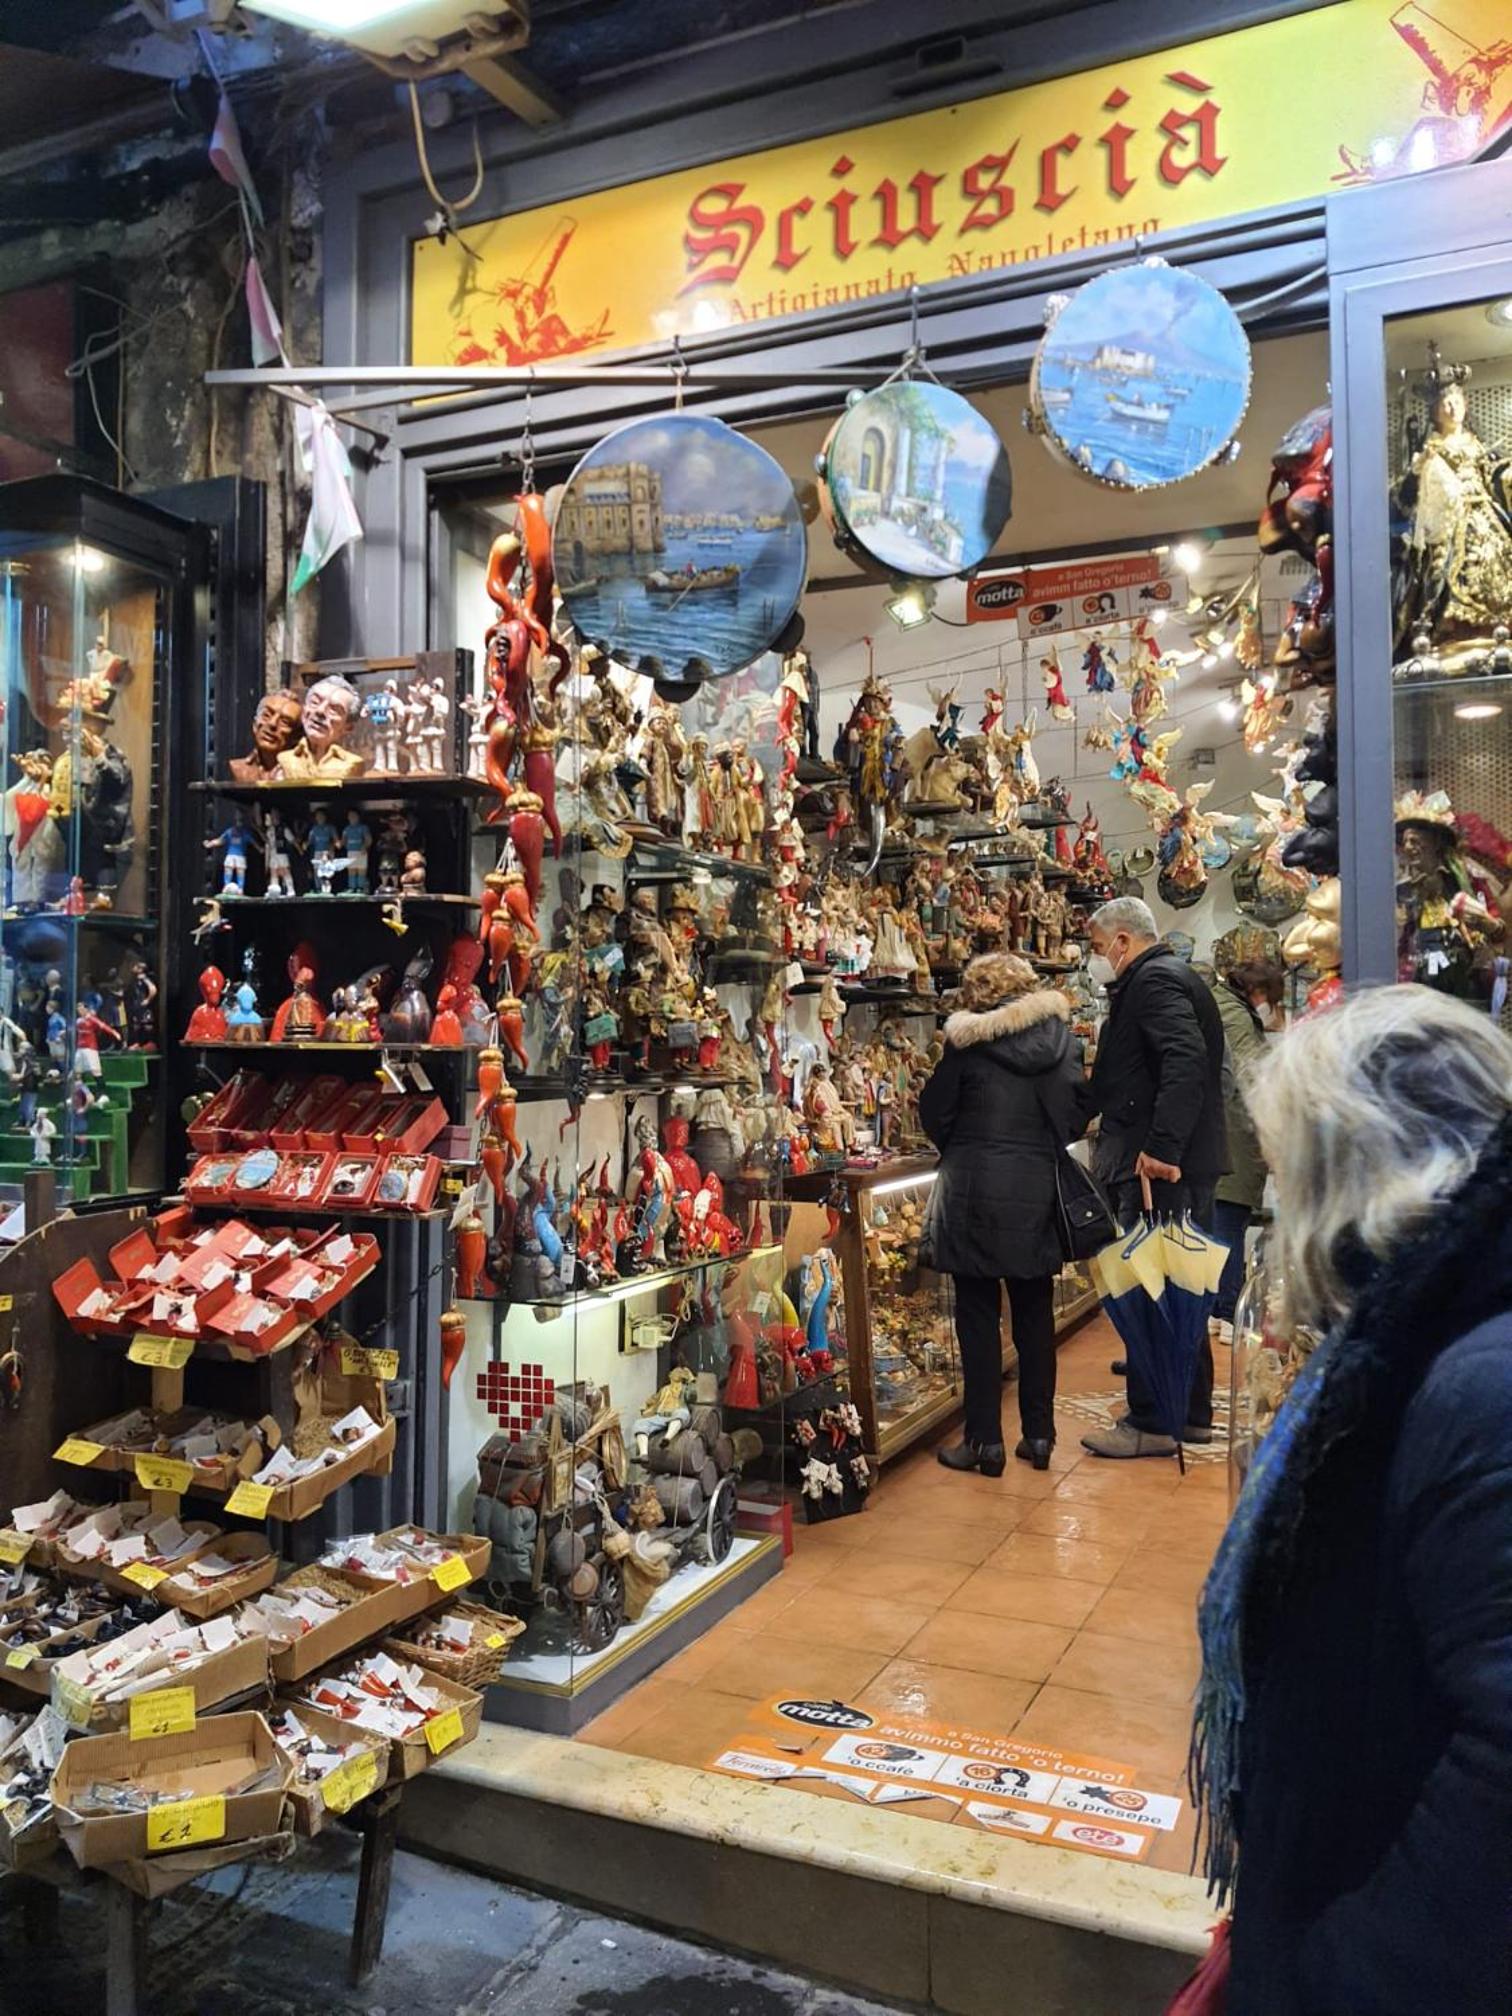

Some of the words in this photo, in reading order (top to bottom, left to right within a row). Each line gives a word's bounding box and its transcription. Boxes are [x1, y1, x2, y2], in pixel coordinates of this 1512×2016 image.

[679, 71, 1229, 294] Sciuscià
[976, 585, 1024, 604] motta
[1073, 578, 1101, 591] fatto
[779, 1704, 871, 1728] motta
[880, 1726, 963, 1749] avimmo
[968, 1743, 1020, 1761] fatto
[1054, 1762, 1125, 1784] terno!
[961, 1732, 990, 1743] San
[994, 1739, 1064, 1759] Gregorio
[975, 1783, 1028, 1798] ciorta
[1083, 1803, 1162, 1824] presepe
